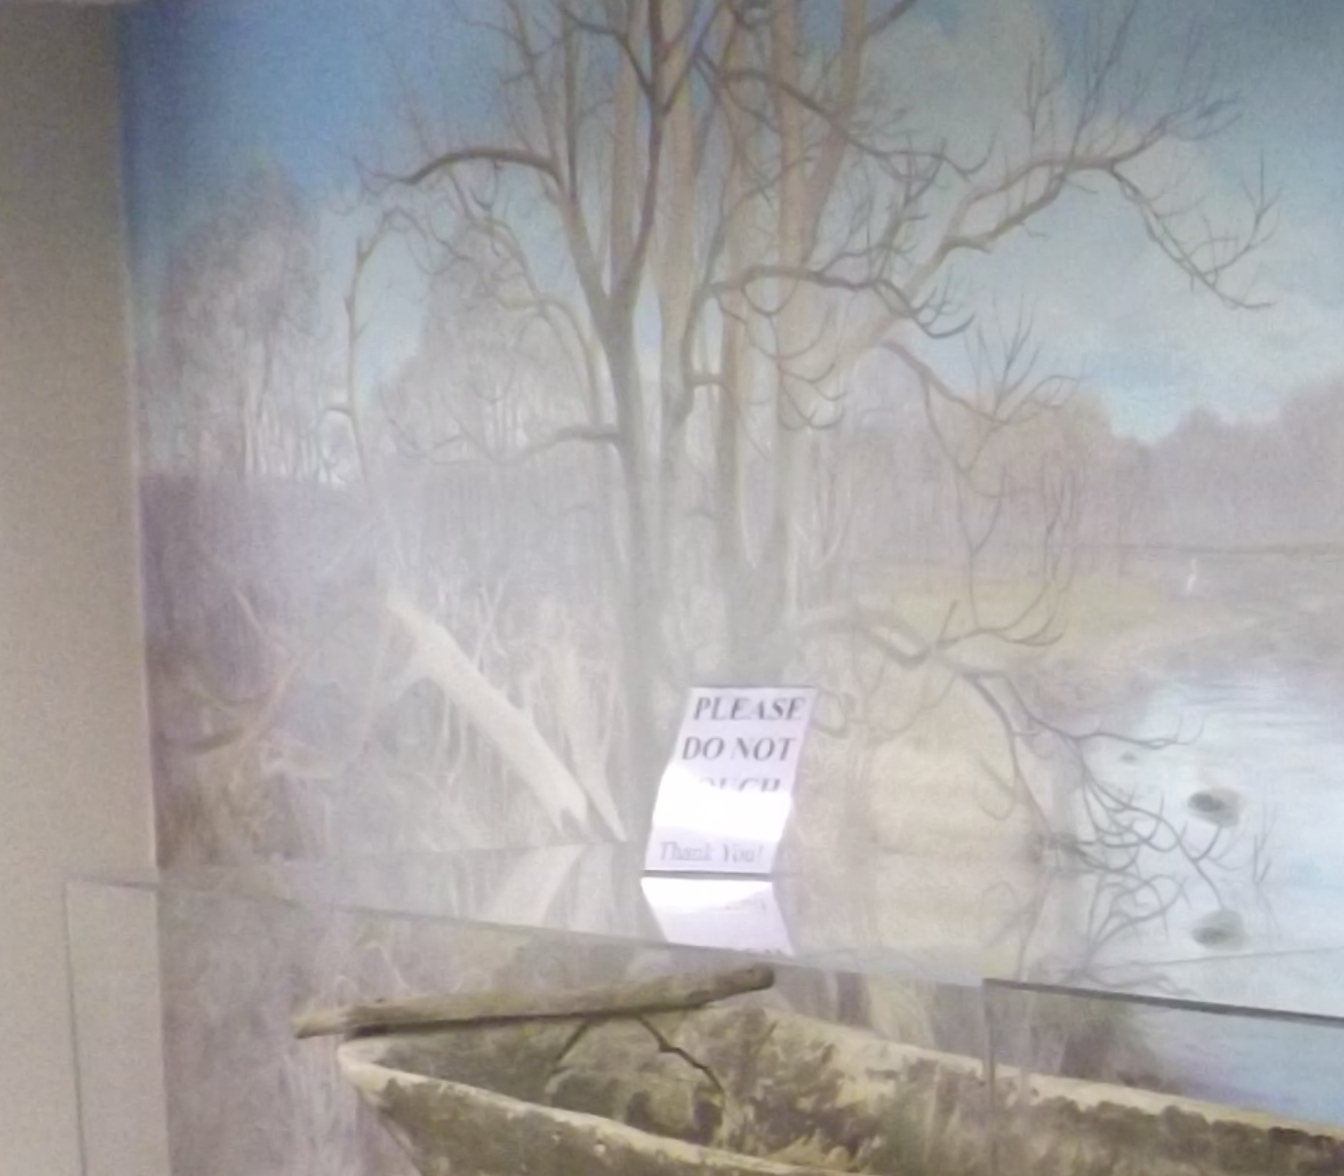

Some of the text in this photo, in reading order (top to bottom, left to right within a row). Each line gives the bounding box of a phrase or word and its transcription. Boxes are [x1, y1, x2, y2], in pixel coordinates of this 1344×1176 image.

[693, 697, 807, 720] PLEASE
[682, 736, 797, 761] DO NOT
[659, 841, 764, 864] Thank You!
